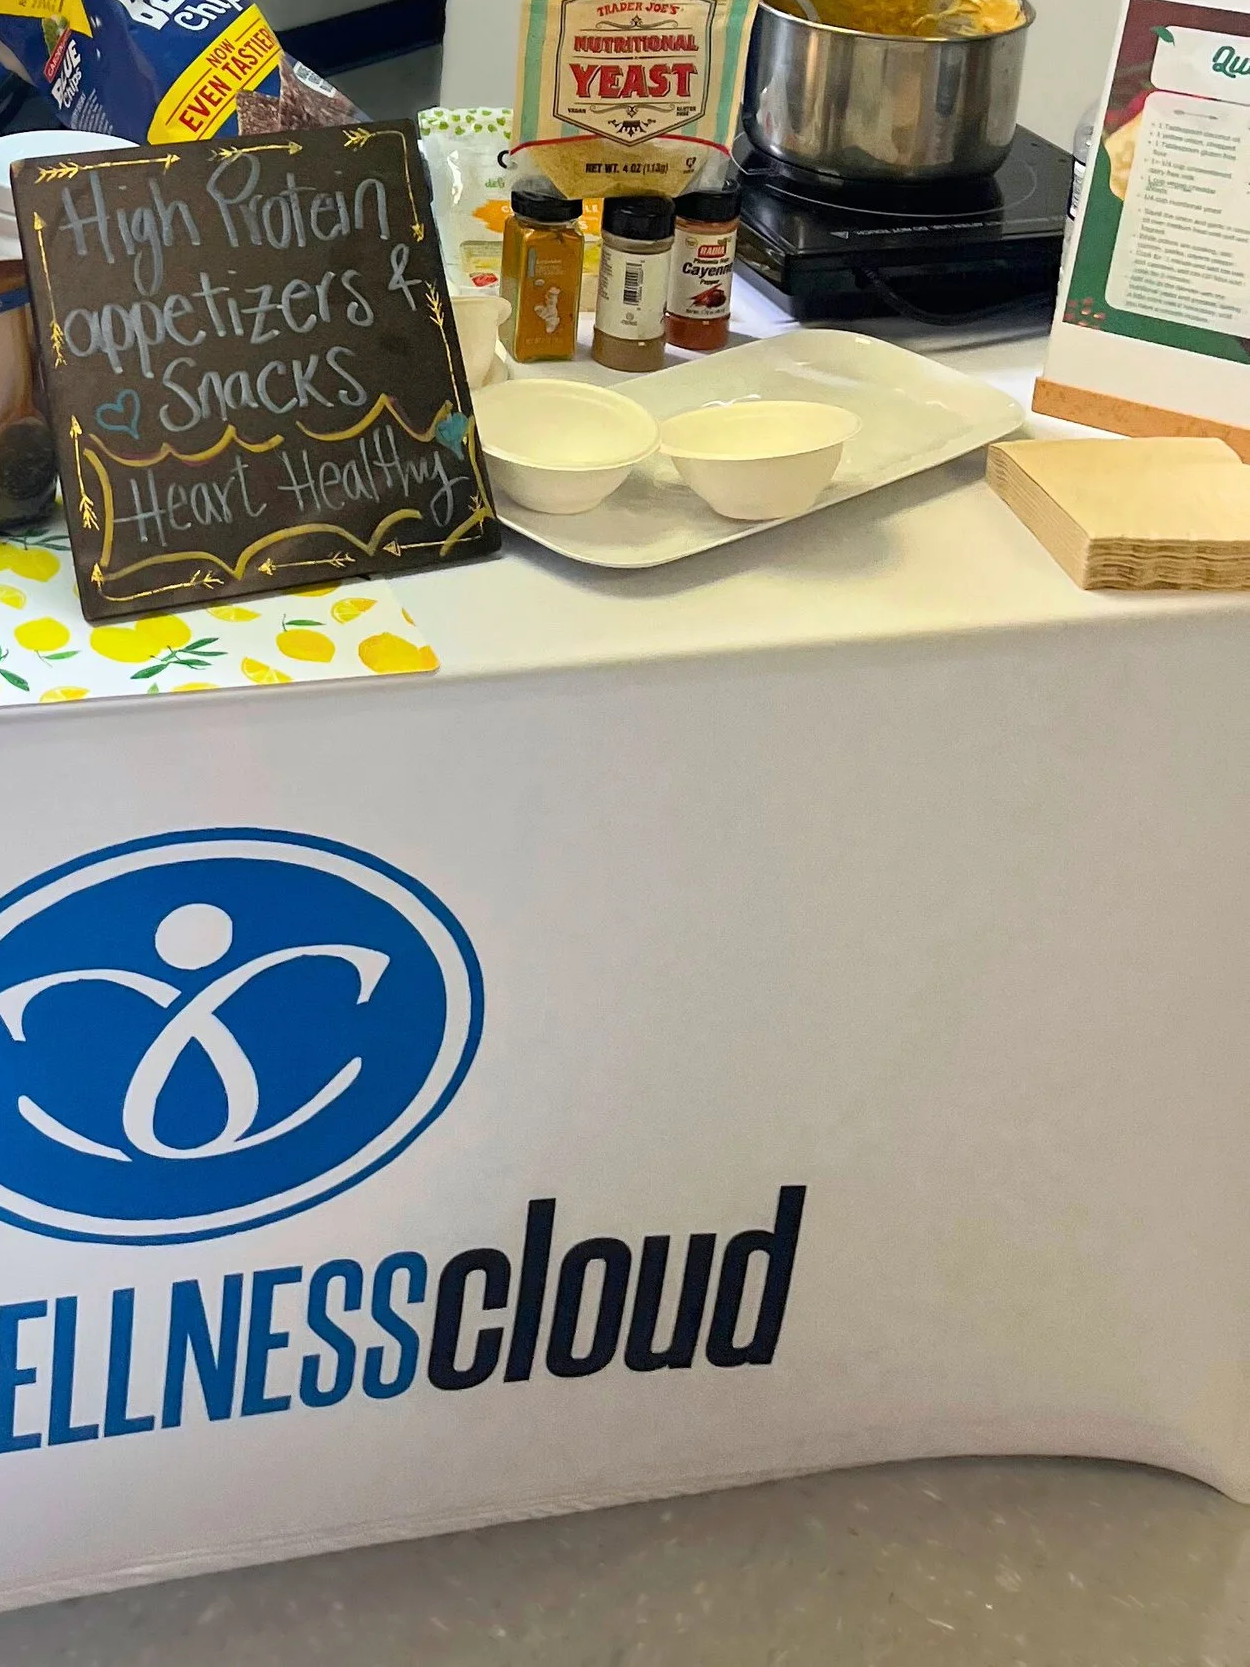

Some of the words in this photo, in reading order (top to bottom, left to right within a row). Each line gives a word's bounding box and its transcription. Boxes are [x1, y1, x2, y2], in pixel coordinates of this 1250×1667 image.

[597, 2, 643, 17] TRADER
[645, 2, 680, 15] JOE'S
[206, 38, 237, 69] NOW
[573, 34, 700, 54] NUTRITIONAL
[569, 62, 698, 99] YEAST
[178, 76, 231, 133] EVEN
[585, 163, 602, 174] NET
[622, 164, 629, 173] 4
[630, 163, 641, 173] OZ
[58, 171, 202, 296] High
[207, 153, 391, 249] Protein
[64, 269, 374, 379] appetizers
[388, 243, 422, 311] &
[113, 454, 267, 547] Heart
[277, 425, 470, 528] Healthy
